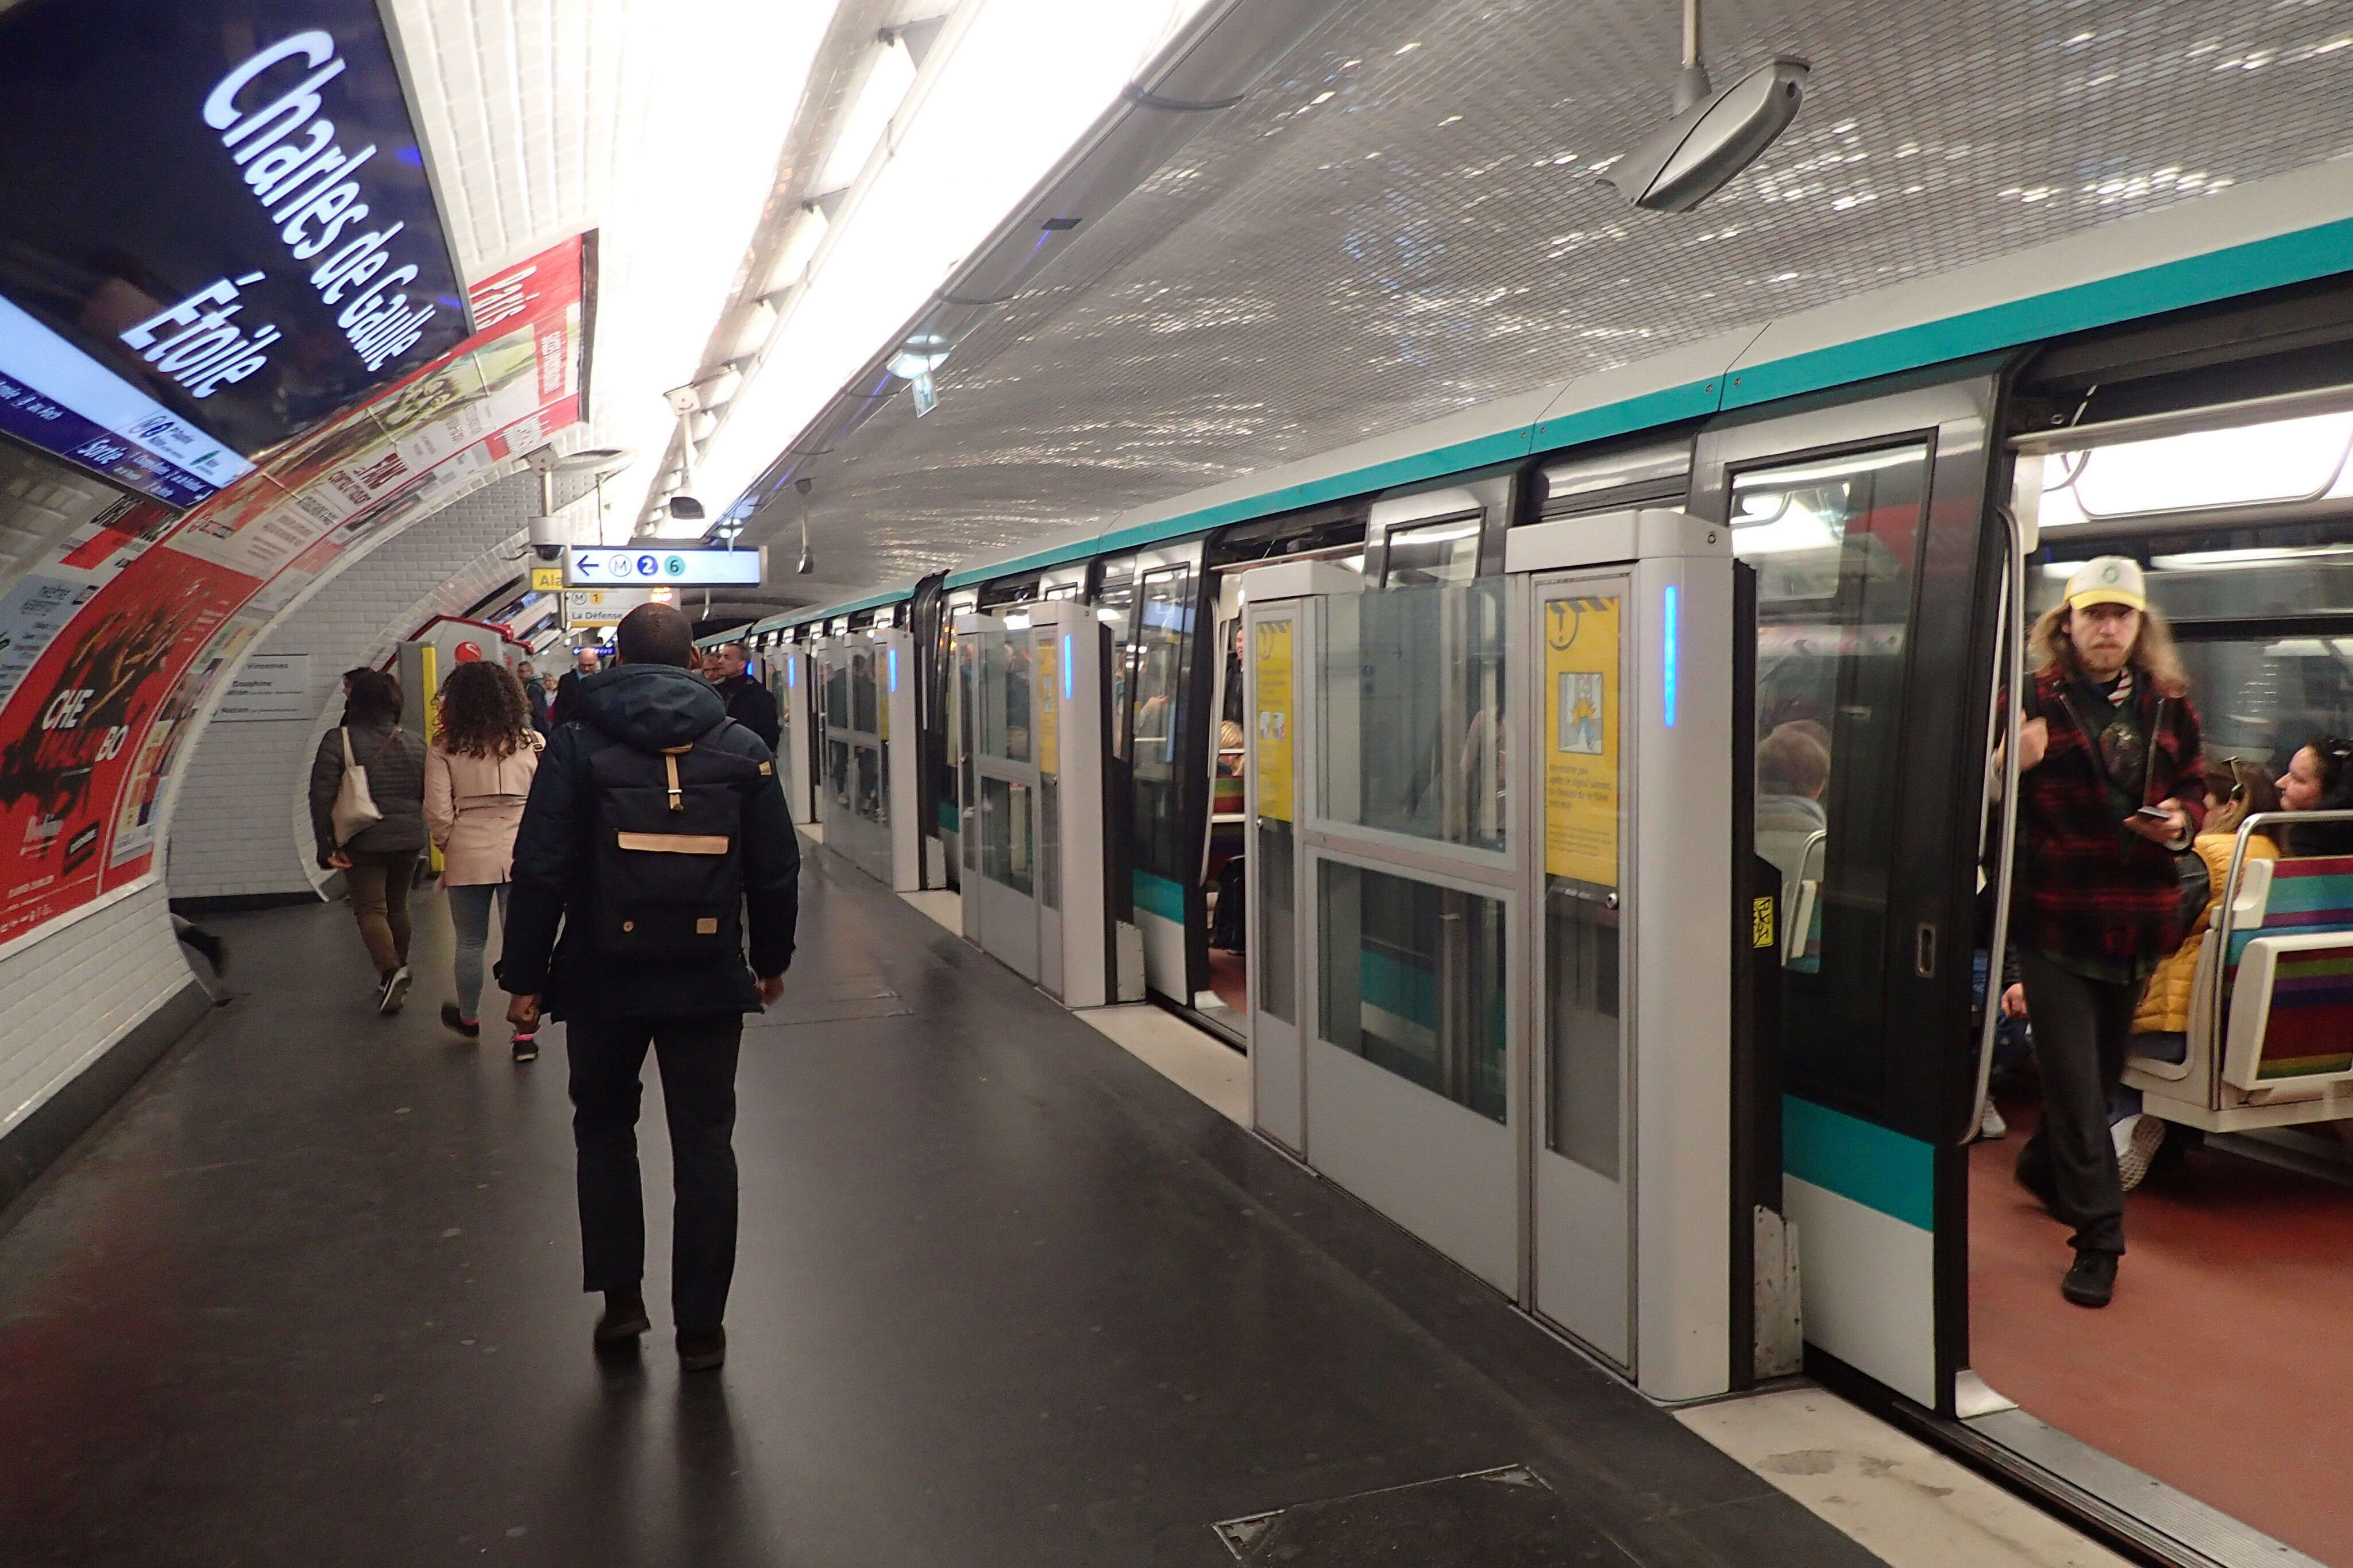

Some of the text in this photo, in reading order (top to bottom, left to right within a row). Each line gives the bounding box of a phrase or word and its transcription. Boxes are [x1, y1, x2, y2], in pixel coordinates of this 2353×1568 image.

[203, 29, 377, 260] Charles
[310, 220, 404, 305] de
[119, 270, 282, 397] Étoile
[337, 264, 437, 372] Gaulle
[77, 439, 128, 465] Sortie
[642, 558, 653, 574] 2
[669, 559, 679, 573] 6
[585, 611, 622, 620] Défense
[593, 593, 599, 603] 1
